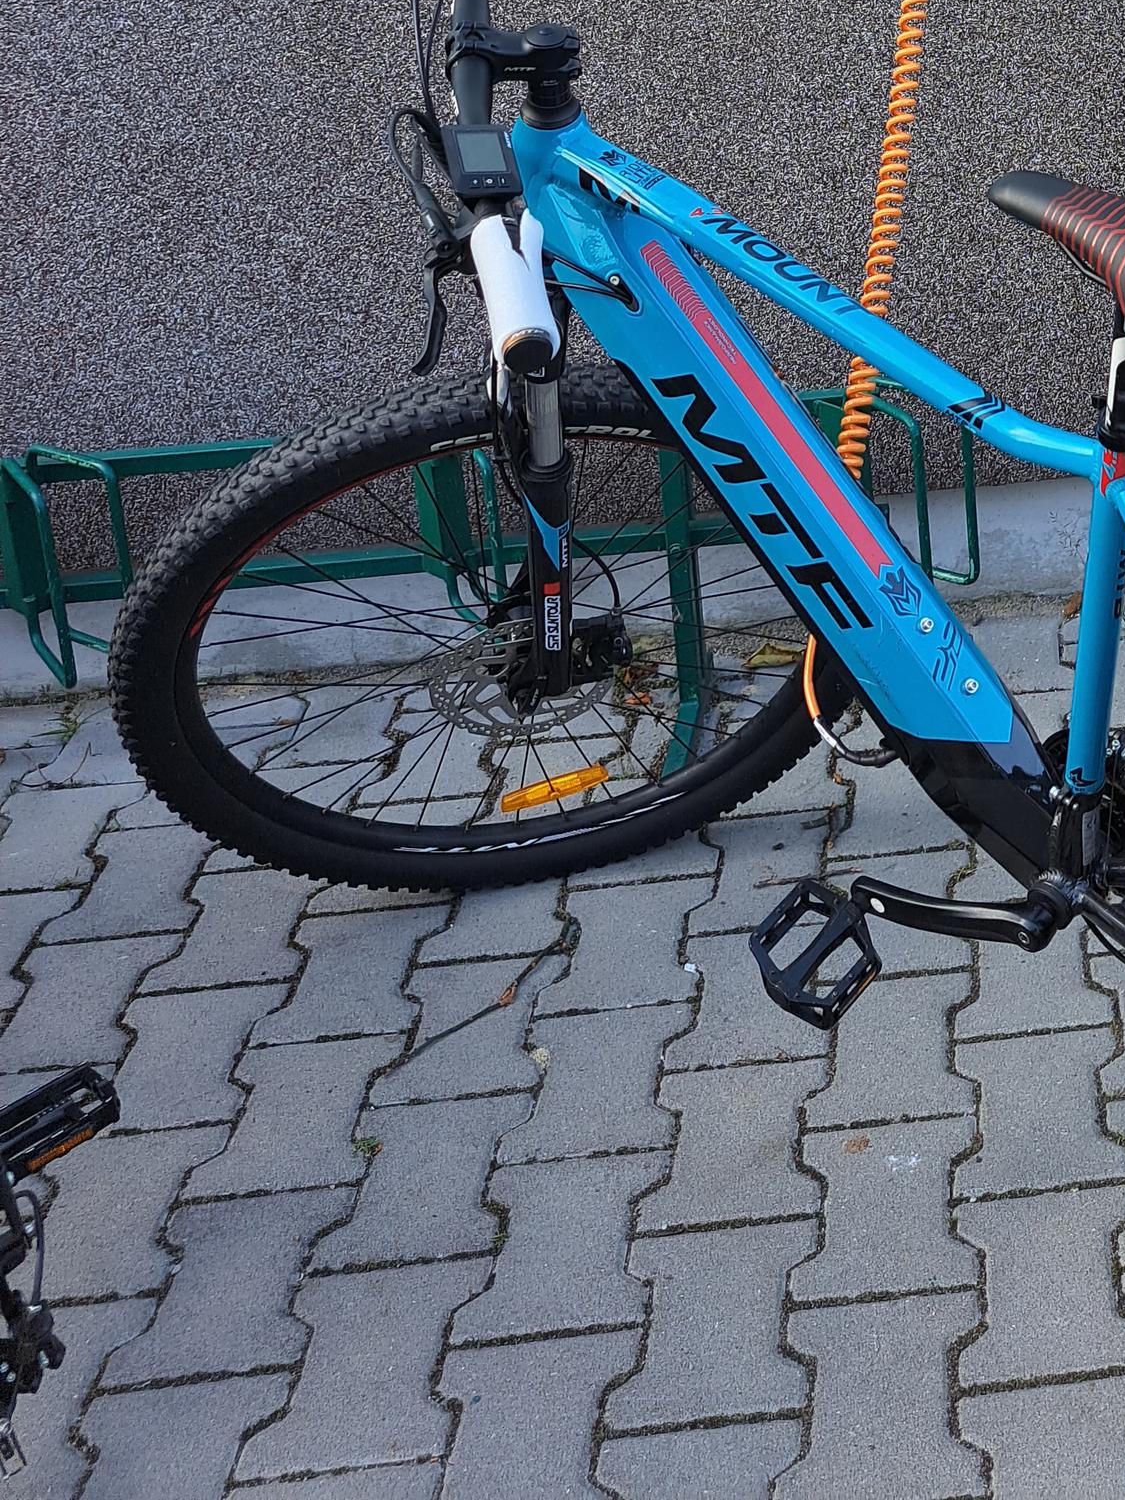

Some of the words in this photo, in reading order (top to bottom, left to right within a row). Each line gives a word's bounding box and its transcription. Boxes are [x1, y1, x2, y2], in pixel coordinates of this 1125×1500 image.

[701, 216, 872, 316] MOUNT
[563, 425, 658, 440] TROL
[650, 373, 874, 630] MTF
[561, 537, 569, 568] MTF
[546, 596, 560, 634] SUNTOUR
[546, 634, 560, 650] SR
